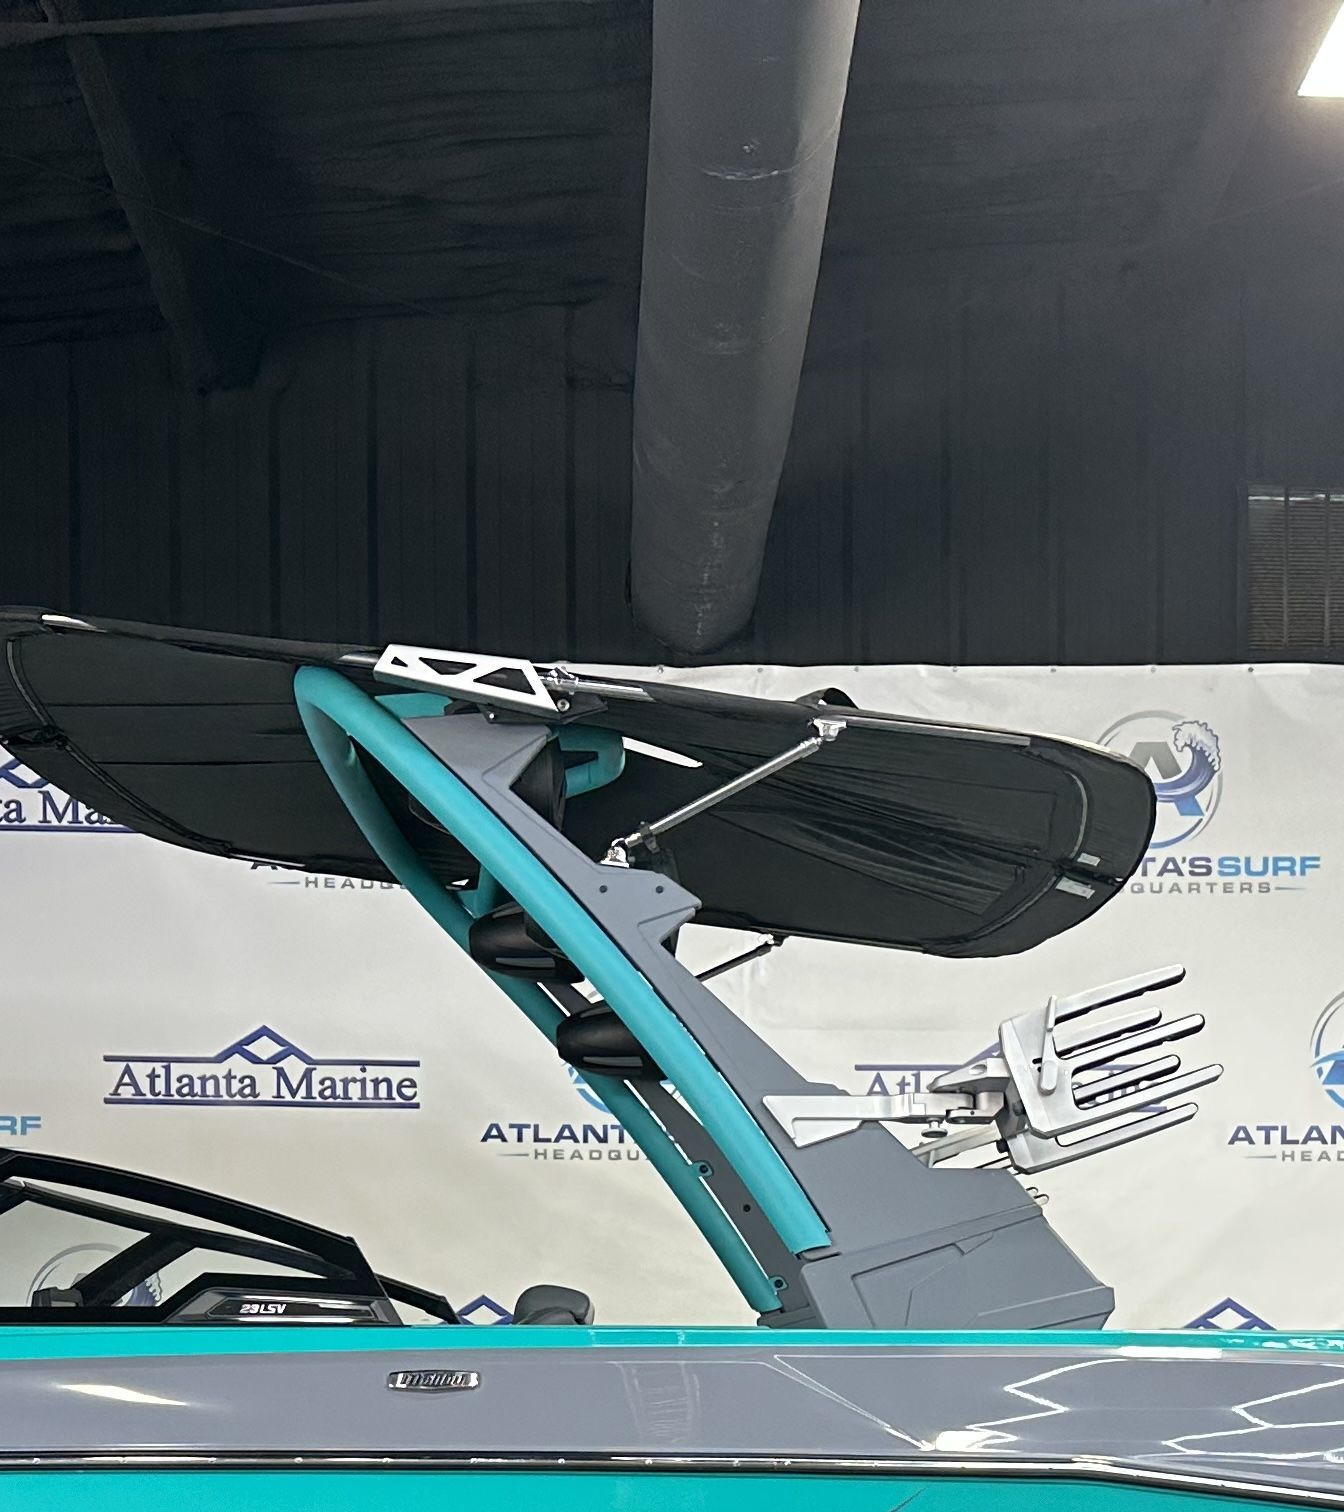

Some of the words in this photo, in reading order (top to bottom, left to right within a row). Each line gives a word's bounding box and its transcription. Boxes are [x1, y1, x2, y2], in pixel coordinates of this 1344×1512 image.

[1218, 856, 1321, 876] SURF
[1131, 882, 1271, 894] QUARTERS
[110, 1063, 259, 1099] Atlanta
[273, 1065, 417, 1101] Marine
[480, 1121, 625, 1144] ATLANT
[534, 1148, 639, 1161] HEADQU
